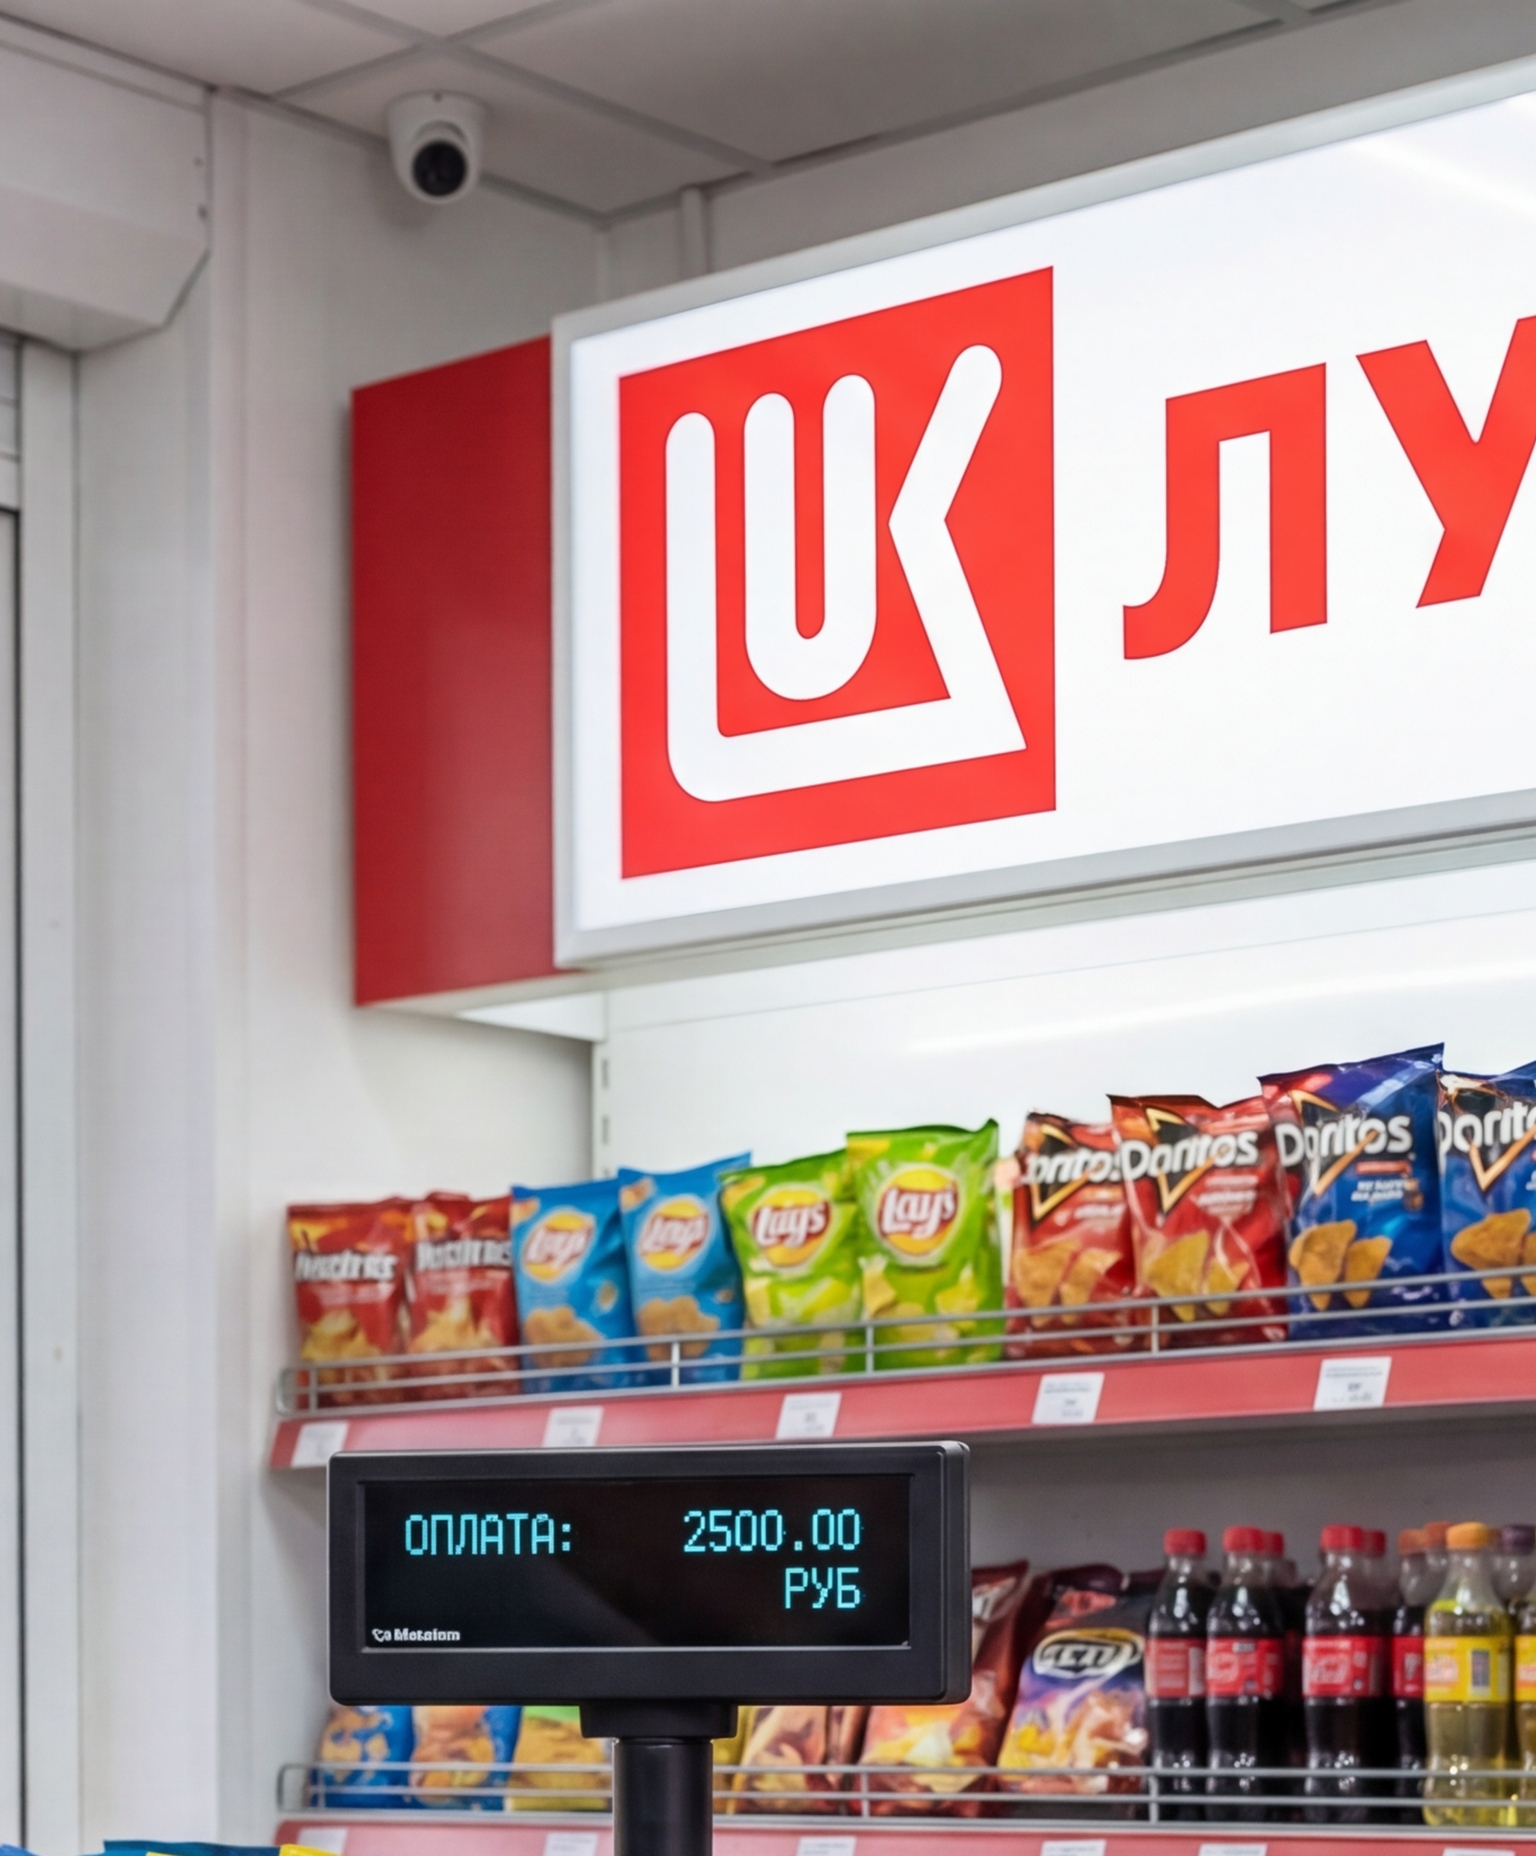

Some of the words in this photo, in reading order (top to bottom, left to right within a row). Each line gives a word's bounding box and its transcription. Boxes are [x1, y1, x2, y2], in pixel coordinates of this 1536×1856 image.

[404, 1512, 572, 1556] ОПЛАТА:
[683, 1508, 862, 1553] 2500.00
[785, 1567, 862, 1609] РУБ
